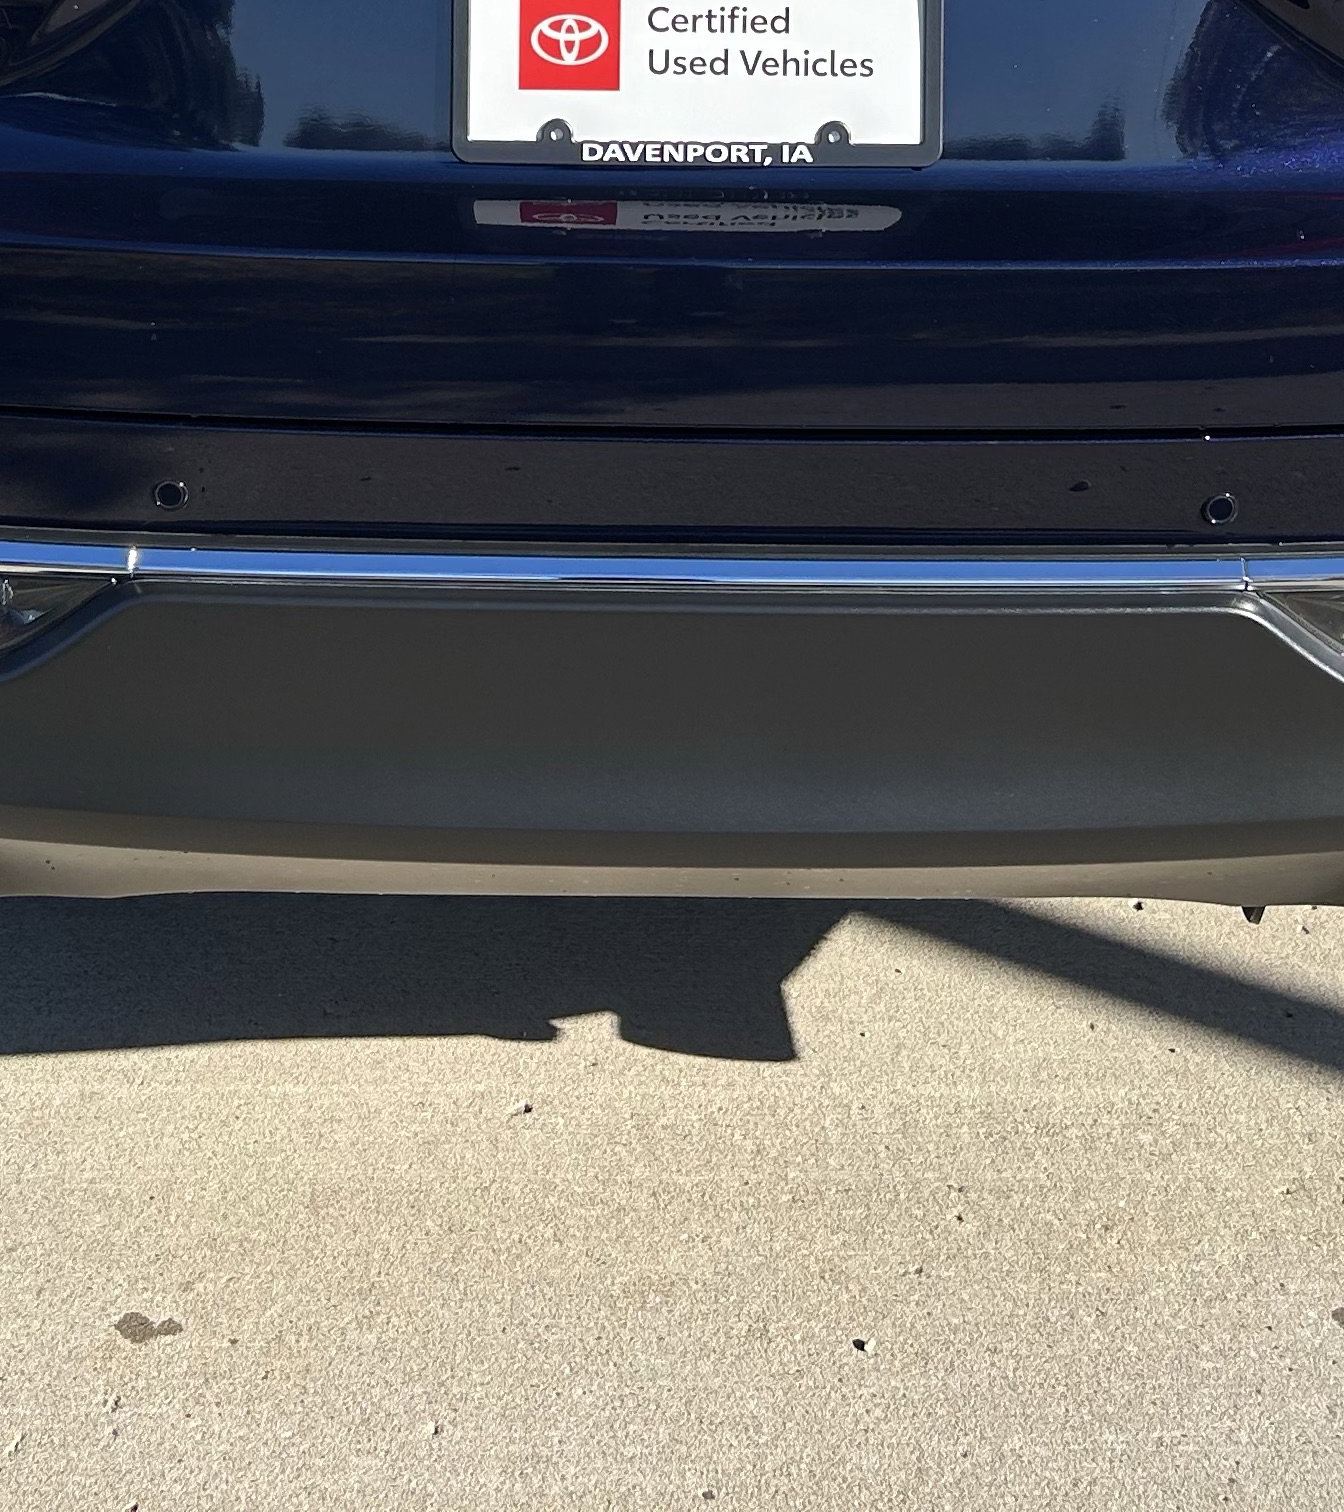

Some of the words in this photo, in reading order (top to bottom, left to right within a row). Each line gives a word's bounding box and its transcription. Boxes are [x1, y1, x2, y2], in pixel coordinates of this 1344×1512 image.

[647, 6, 790, 35] Certified
[647, 49, 729, 76] Used
[740, 50, 874, 78] Vehicles
[581, 142, 772, 167] DAVENPORT,
[781, 144, 813, 163] IA
